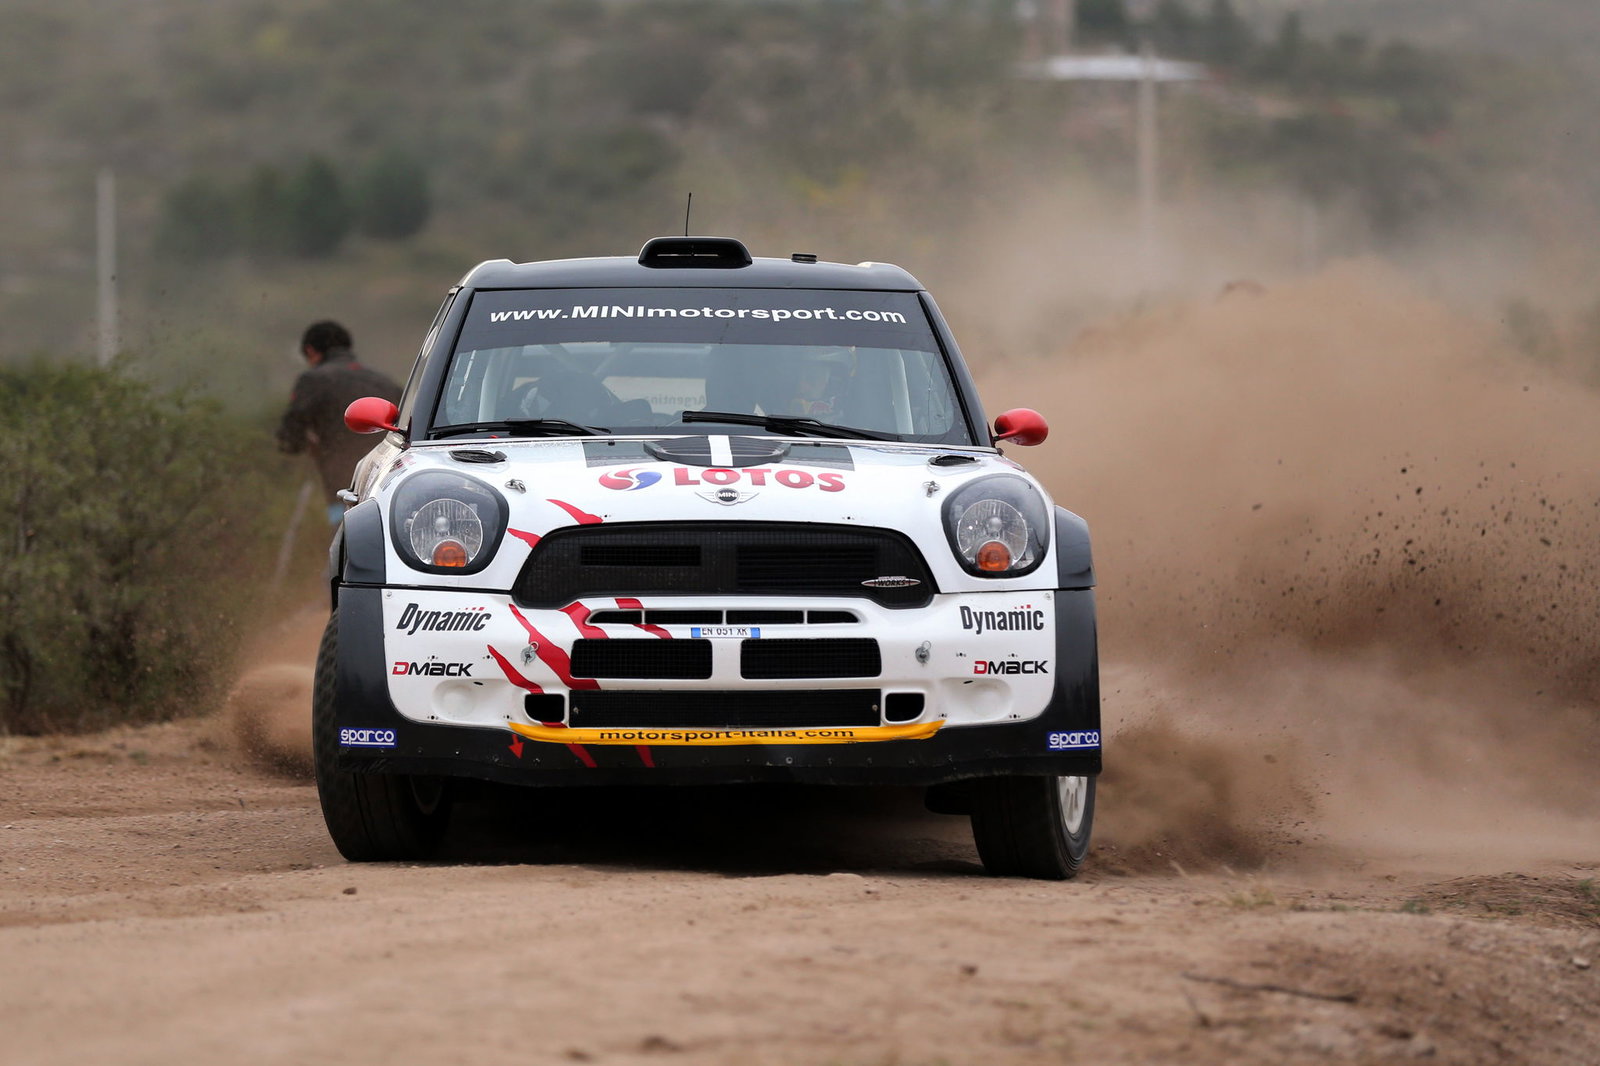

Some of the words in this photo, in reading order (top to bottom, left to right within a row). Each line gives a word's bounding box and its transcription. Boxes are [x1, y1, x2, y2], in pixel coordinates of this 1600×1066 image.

[490, 305, 907, 323] www.MINImotorsport.com
[673, 467, 846, 493] LOTOS
[396, 603, 492, 635] Dynamic
[960, 605, 1044, 635] Dynamic
[702, 627, 713, 636] EN
[716, 627, 733, 636] 051
[340, 729, 395, 746] sparco
[1049, 731, 1100, 749] sparco
